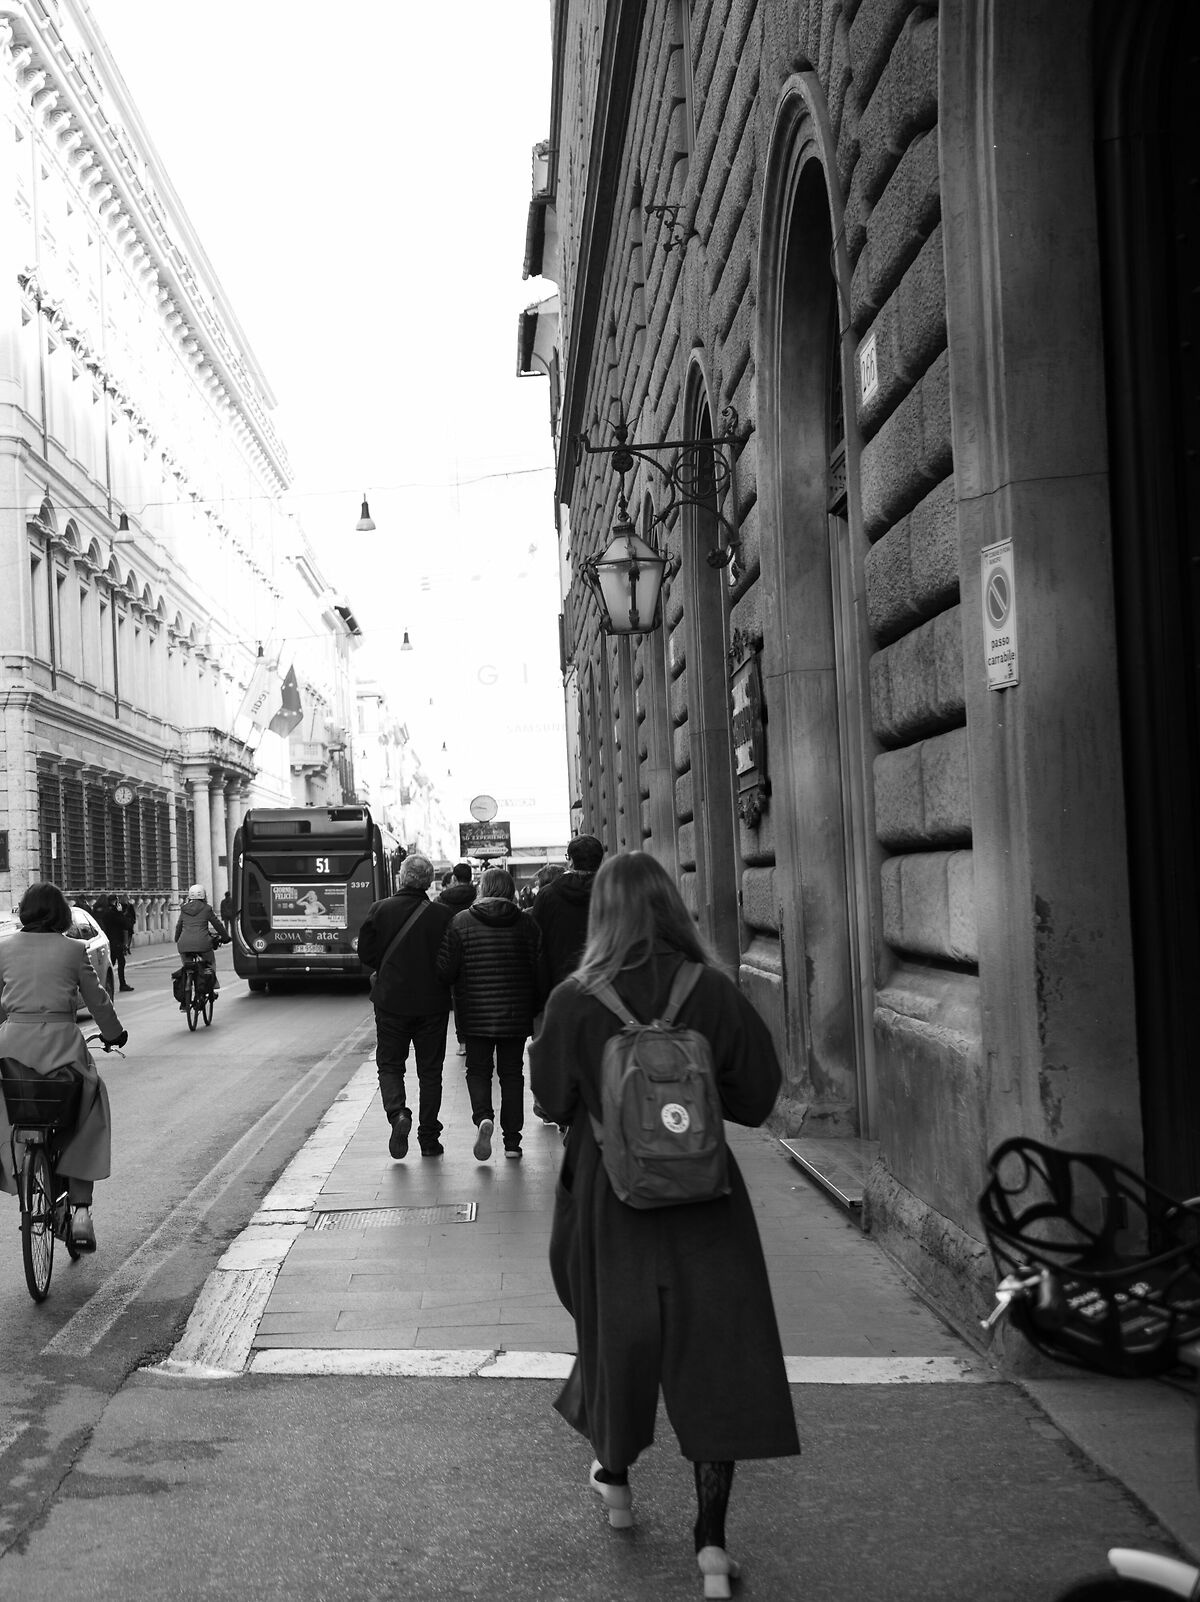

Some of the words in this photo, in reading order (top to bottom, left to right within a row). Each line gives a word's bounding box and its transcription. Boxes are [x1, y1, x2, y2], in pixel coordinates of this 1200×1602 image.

[862, 346, 875, 393] 266
[991, 636, 1010, 652] passo
[988, 649, 1015, 667] carrabile
[316, 857, 330, 873] 51
[351, 881, 370, 889] 3397
[274, 932, 302, 943] ROMA
[316, 931, 339, 941] atac
